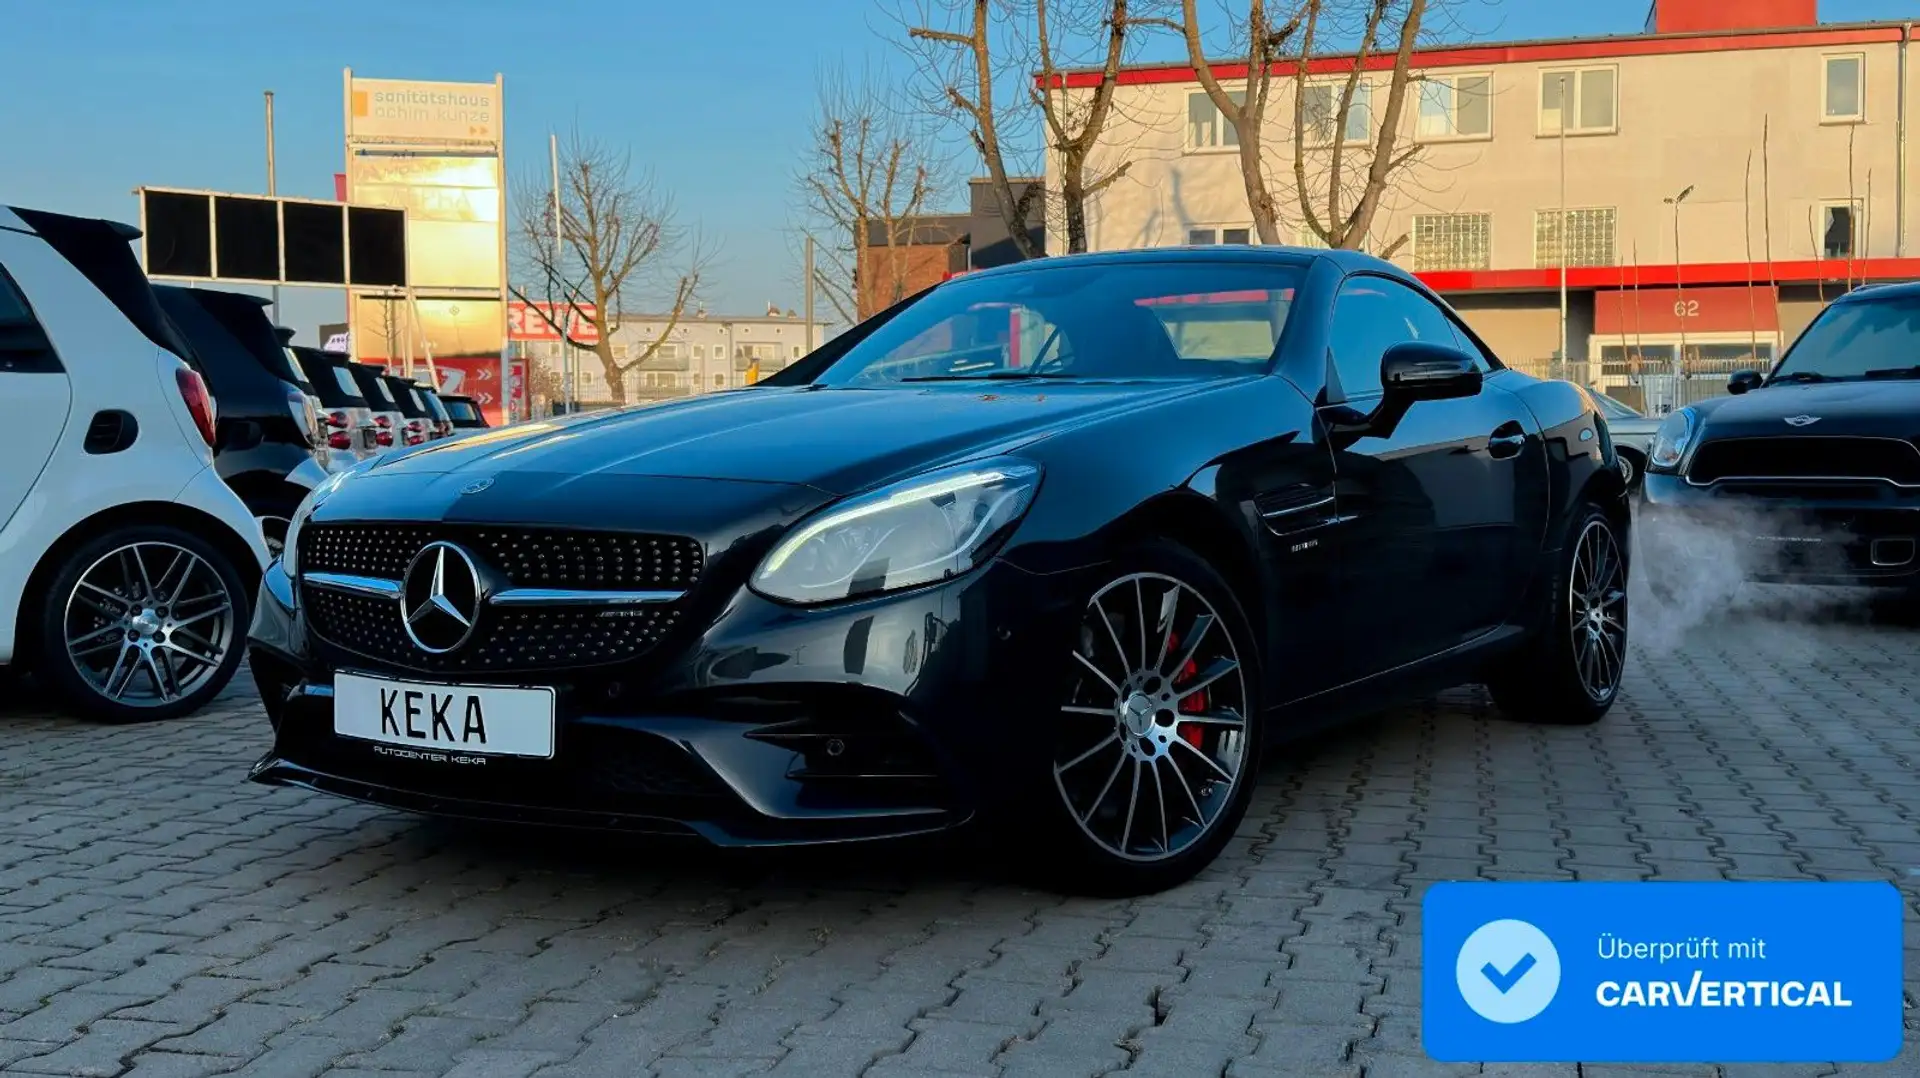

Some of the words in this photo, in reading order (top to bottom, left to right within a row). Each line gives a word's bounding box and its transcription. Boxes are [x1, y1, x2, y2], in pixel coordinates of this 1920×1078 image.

[374, 105, 430, 122] achim
[1674, 300, 1699, 317] 62
[380, 687, 487, 744] KEKA
[373, 745, 447, 762] AUTOCENTER
[451, 755, 486, 765] KEKA
